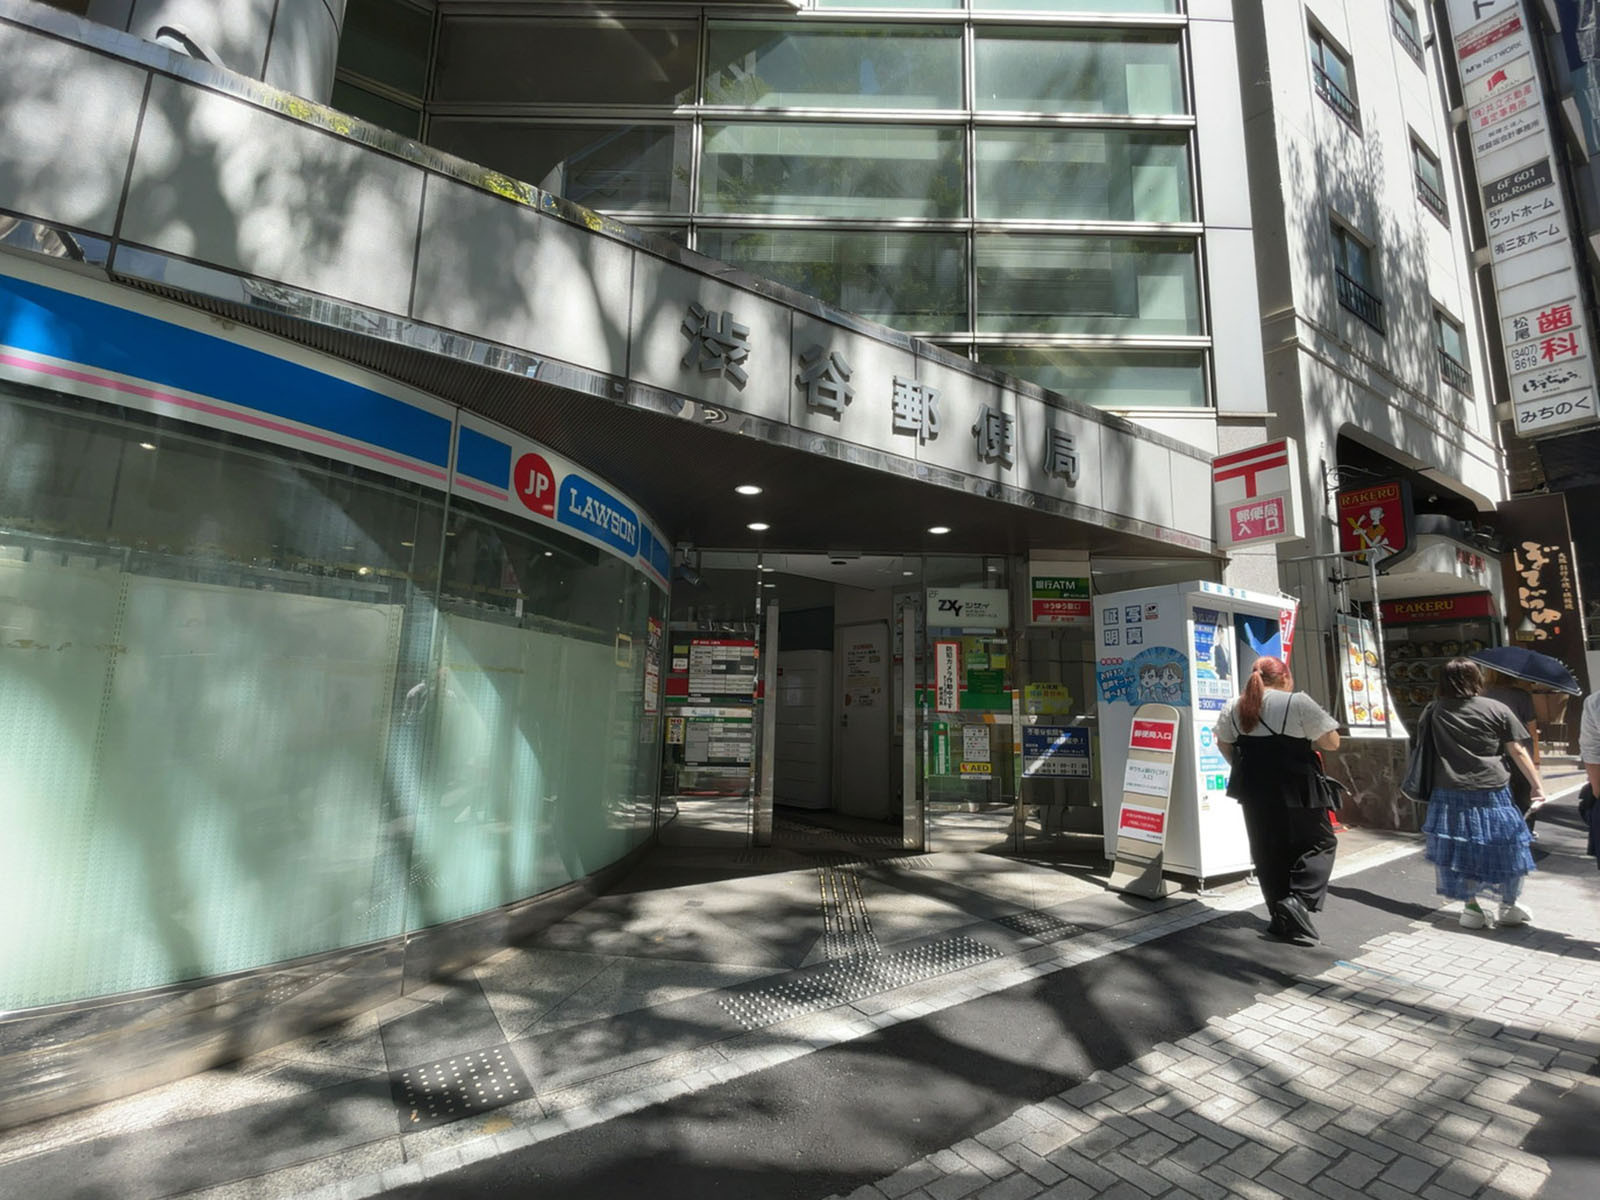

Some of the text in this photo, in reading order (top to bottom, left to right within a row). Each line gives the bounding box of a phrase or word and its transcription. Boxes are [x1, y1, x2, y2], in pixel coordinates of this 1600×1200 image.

[1483, 41, 1522, 66] NETWORK
[1497, 168, 1535, 190] 6F 601
[1490, 197, 1554, 230] ウッドホーム
[1513, 316, 1530, 341] 松尾
[1536, 304, 1579, 362] 歯科
[1511, 344, 1538, 360] (3407)
[1514, 355, 1537, 371] 8619
[680, 302, 1081, 488] 渋谷郵便局
[1521, 396, 1591, 423] みちのく
[524, 469, 550, 498] JP
[1341, 487, 1396, 506] RAKERU
[569, 487, 636, 546] LAWSON
[1237, 503, 1278, 524] 郵便局
[1238, 517, 1279, 536] 入口
[938, 599, 963, 617] ZXY
[1395, 601, 1454, 614] RAKERU
[1134, 729, 1172, 741] 郵便局入口
